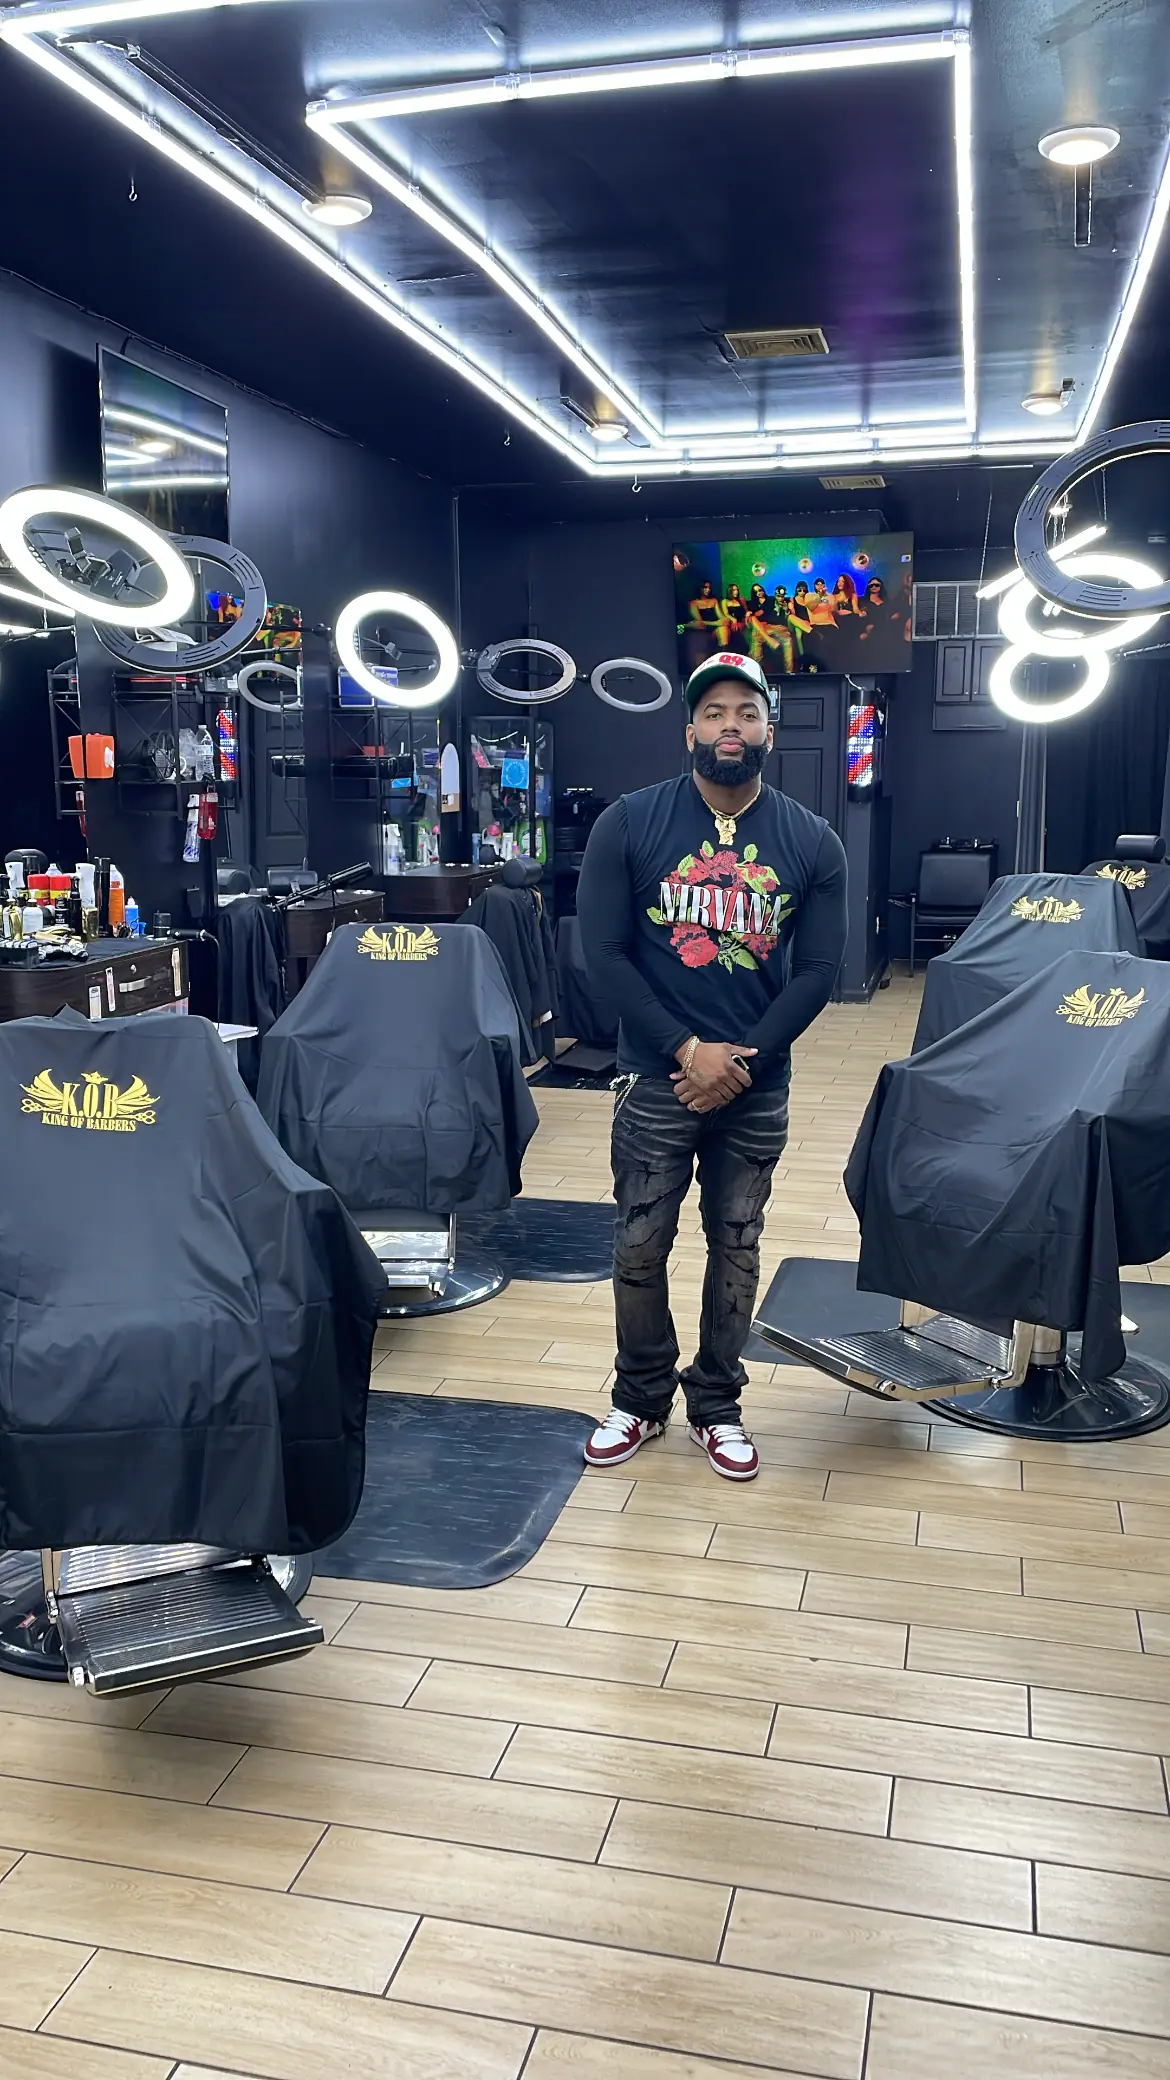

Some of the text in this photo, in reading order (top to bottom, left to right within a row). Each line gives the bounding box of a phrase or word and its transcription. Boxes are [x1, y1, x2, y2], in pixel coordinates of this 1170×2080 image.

[659, 882, 782, 935] NIRVANA
[382, 932, 416, 953] K.O.B
[60, 1081, 119, 1119] K.O.B
[42, 1112, 136, 1132] KING OF BARBERS
